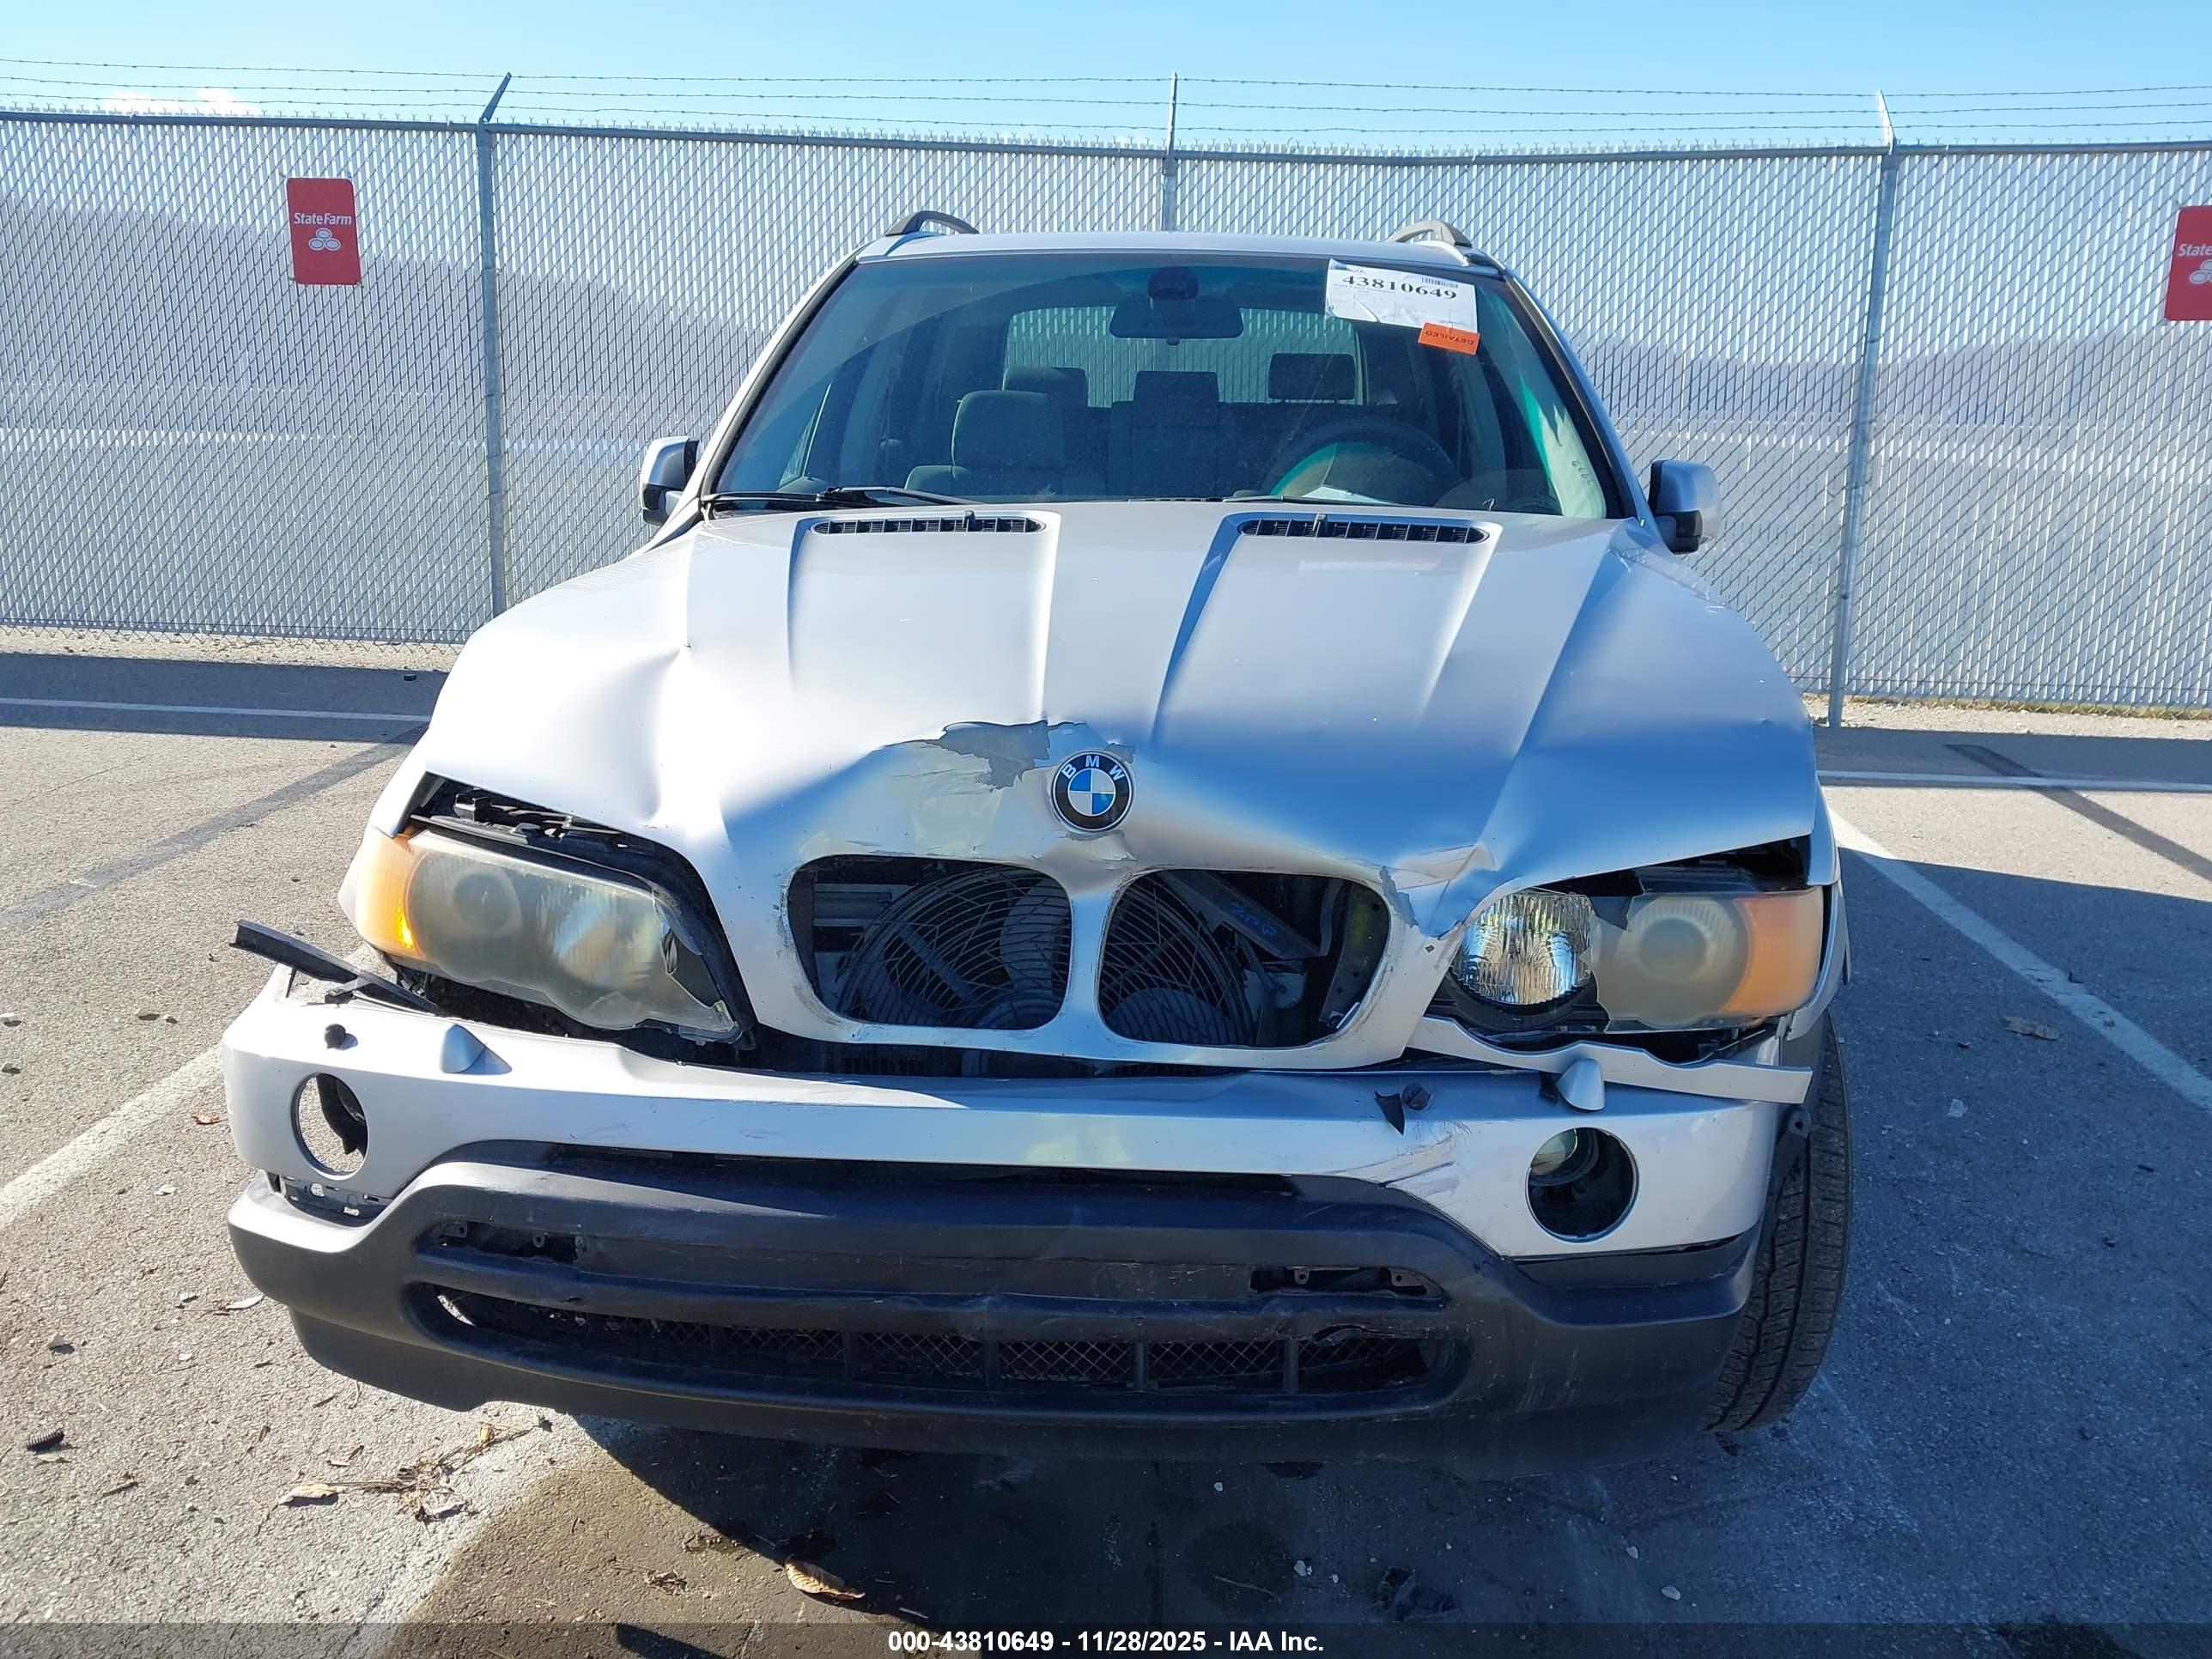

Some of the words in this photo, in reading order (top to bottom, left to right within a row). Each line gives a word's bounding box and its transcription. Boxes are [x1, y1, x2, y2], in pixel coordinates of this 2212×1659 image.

[1342, 275, 1458, 300] 43810649
[1425, 331, 1475, 345] DETAILED
[1060, 755, 1126, 781] BMW
